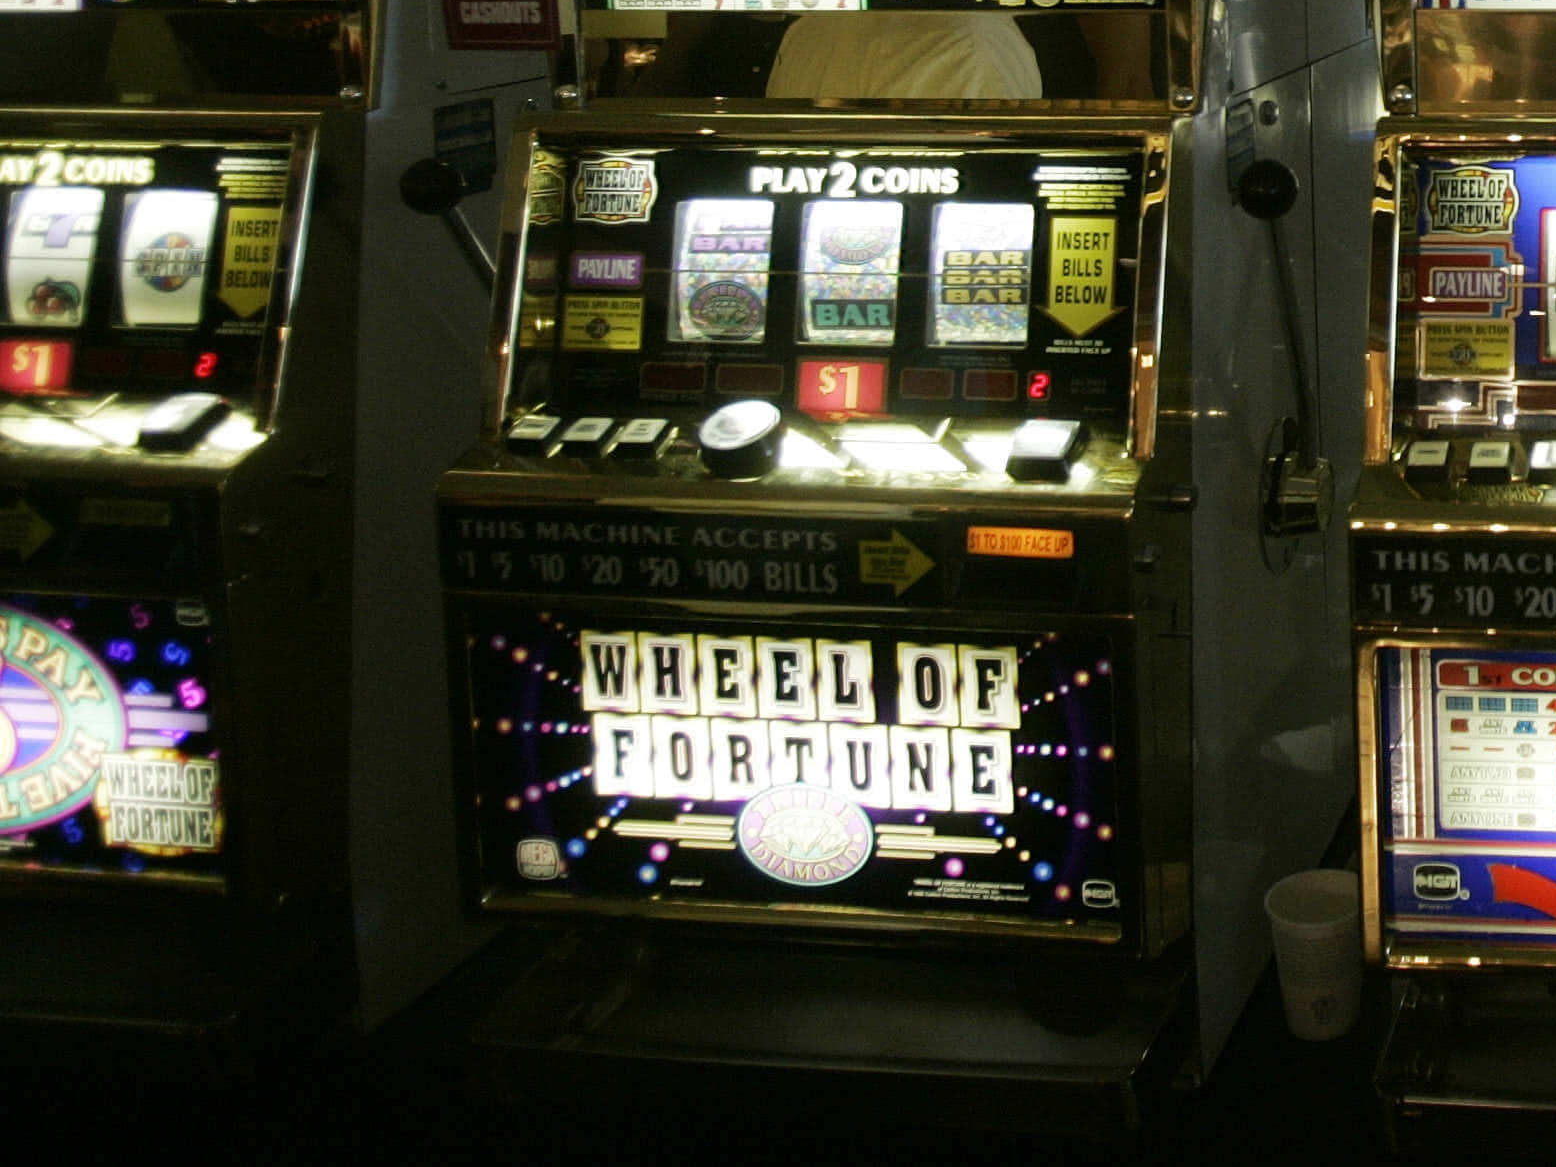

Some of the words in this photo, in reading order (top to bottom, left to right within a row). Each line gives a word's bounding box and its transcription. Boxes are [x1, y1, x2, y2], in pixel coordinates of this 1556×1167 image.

[38, 153, 61, 185] 2
[65, 157, 155, 183] COINS
[584, 169, 625, 188] WHEEL
[626, 169, 644, 188] OF
[750, 167, 828, 192] PLAY
[830, 162, 857, 198] 2
[860, 168, 959, 194] COINS
[1438, 180, 1482, 198] WHEEL
[1487, 179, 1504, 198] OF
[585, 194, 641, 213] FORTUNE
[1439, 206, 1502, 225] FORTUNE
[235, 245, 269, 262] BILLS
[693, 237, 766, 251] BAR
[1057, 233, 1110, 250] INSERT
[577, 259, 636, 280] PAYLINE
[1063, 259, 1102, 277] BILLS
[1056, 286, 1106, 303] BELOW
[1434, 273, 1503, 296] PAYLINE
[815, 304, 891, 326] BAR
[12, 345, 52, 385] $1
[819, 365, 860, 410] $1
[461, 520, 526, 539] THIS
[537, 522, 678, 546] MACHINE
[692, 526, 837, 552] ACCEPTS
[1373, 551, 1449, 572] THIS
[764, 561, 838, 593] BILLS
[1456, 586, 1494, 617] $10
[16, 628, 103, 702] PAY
[590, 642, 863, 707] WHEEL
[915, 657, 1005, 712] OF
[614, 727, 997, 797] FORTUNE
[107, 762, 183, 801] WHEEL
[185, 765, 215, 804] OF
[114, 806, 214, 847] FORTUNE
[751, 843, 860, 880] DIAMOND
